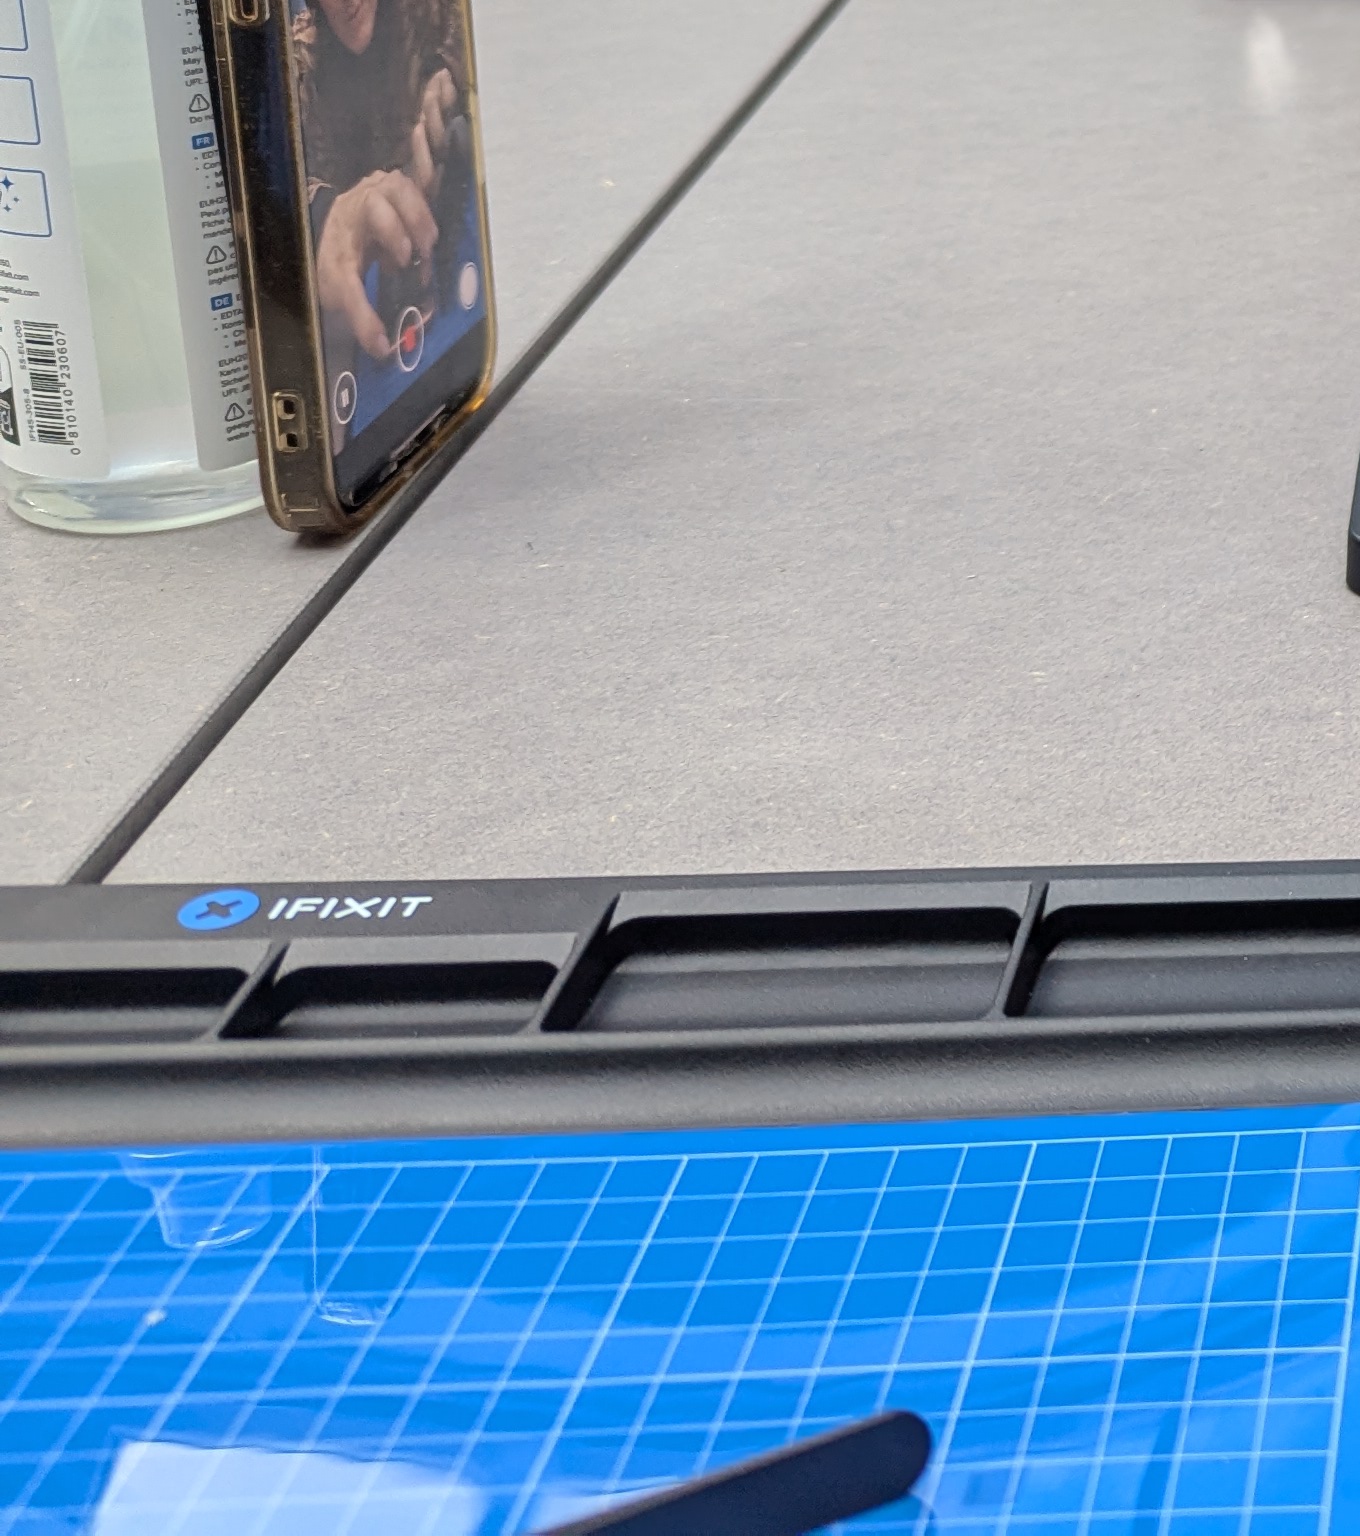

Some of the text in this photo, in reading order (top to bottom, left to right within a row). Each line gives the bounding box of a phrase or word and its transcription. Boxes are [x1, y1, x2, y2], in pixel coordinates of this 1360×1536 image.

[190, 115, 203, 124] Do
[196, 136, 211, 146] FR
[214, 296, 230, 307] DE
[55, 329, 82, 456] 0 810140 230607
[268, 896, 433, 920] IFIXIT
